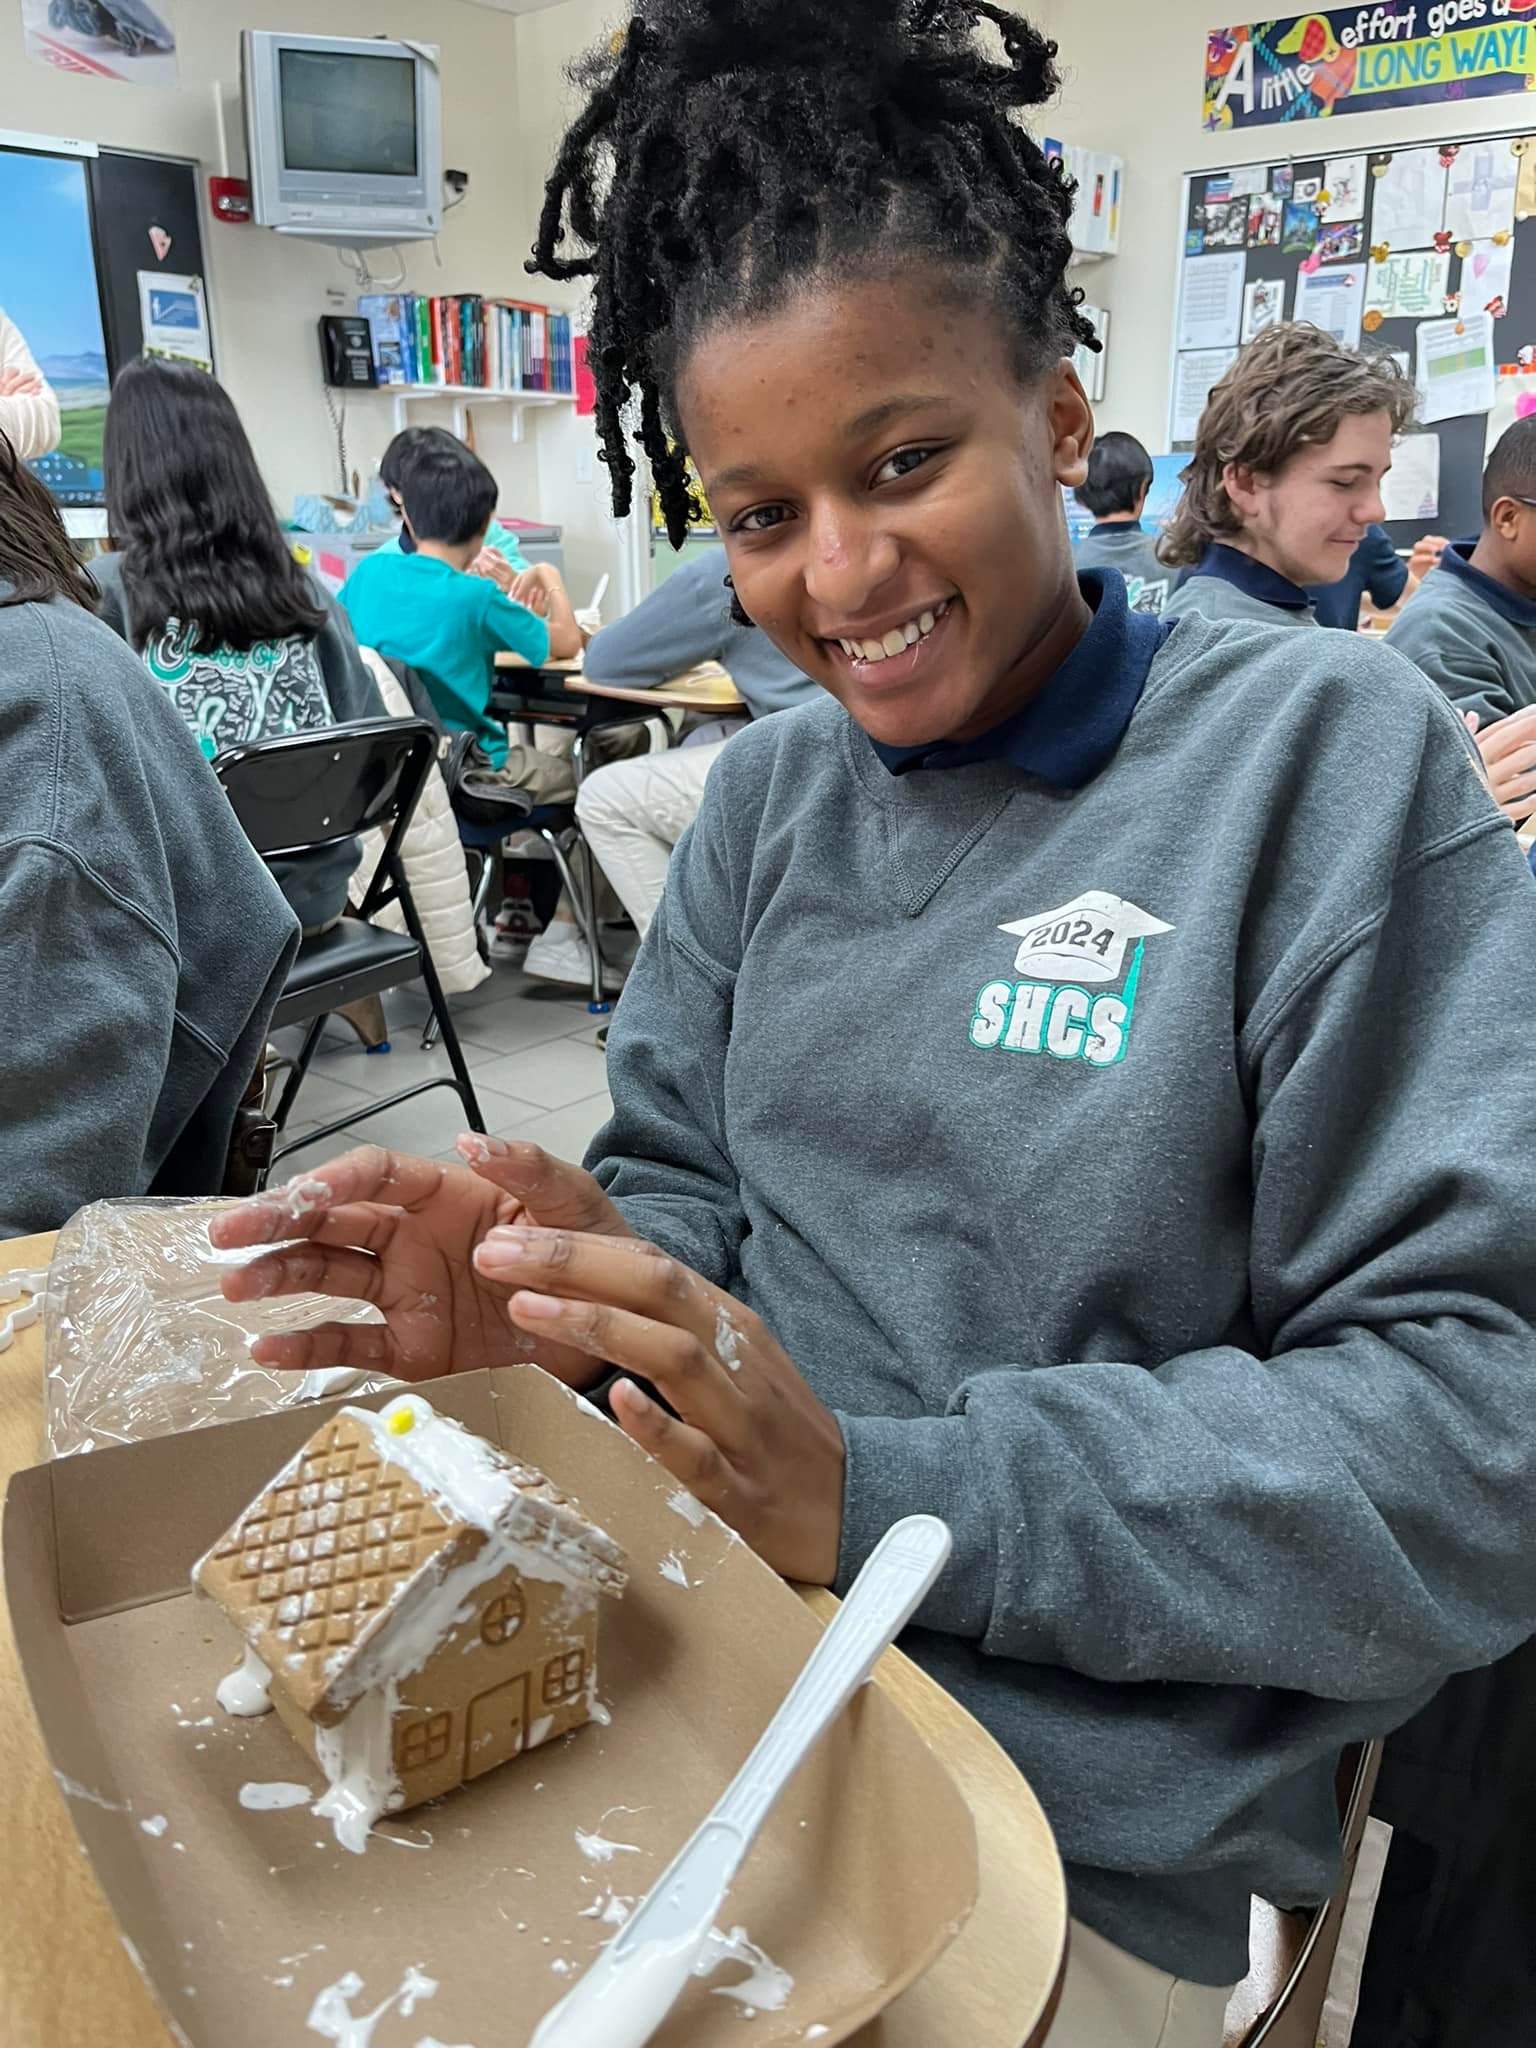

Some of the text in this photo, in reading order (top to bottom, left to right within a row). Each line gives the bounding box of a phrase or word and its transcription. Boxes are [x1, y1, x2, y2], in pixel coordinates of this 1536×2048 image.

[1340, 0, 1509, 49] effort goes a
[1215, 41, 1316, 114] A little
[1358, 25, 1528, 89] LONG WAY!
[1030, 919, 1115, 956] 2024
[969, 980, 1129, 1067] SHCS
